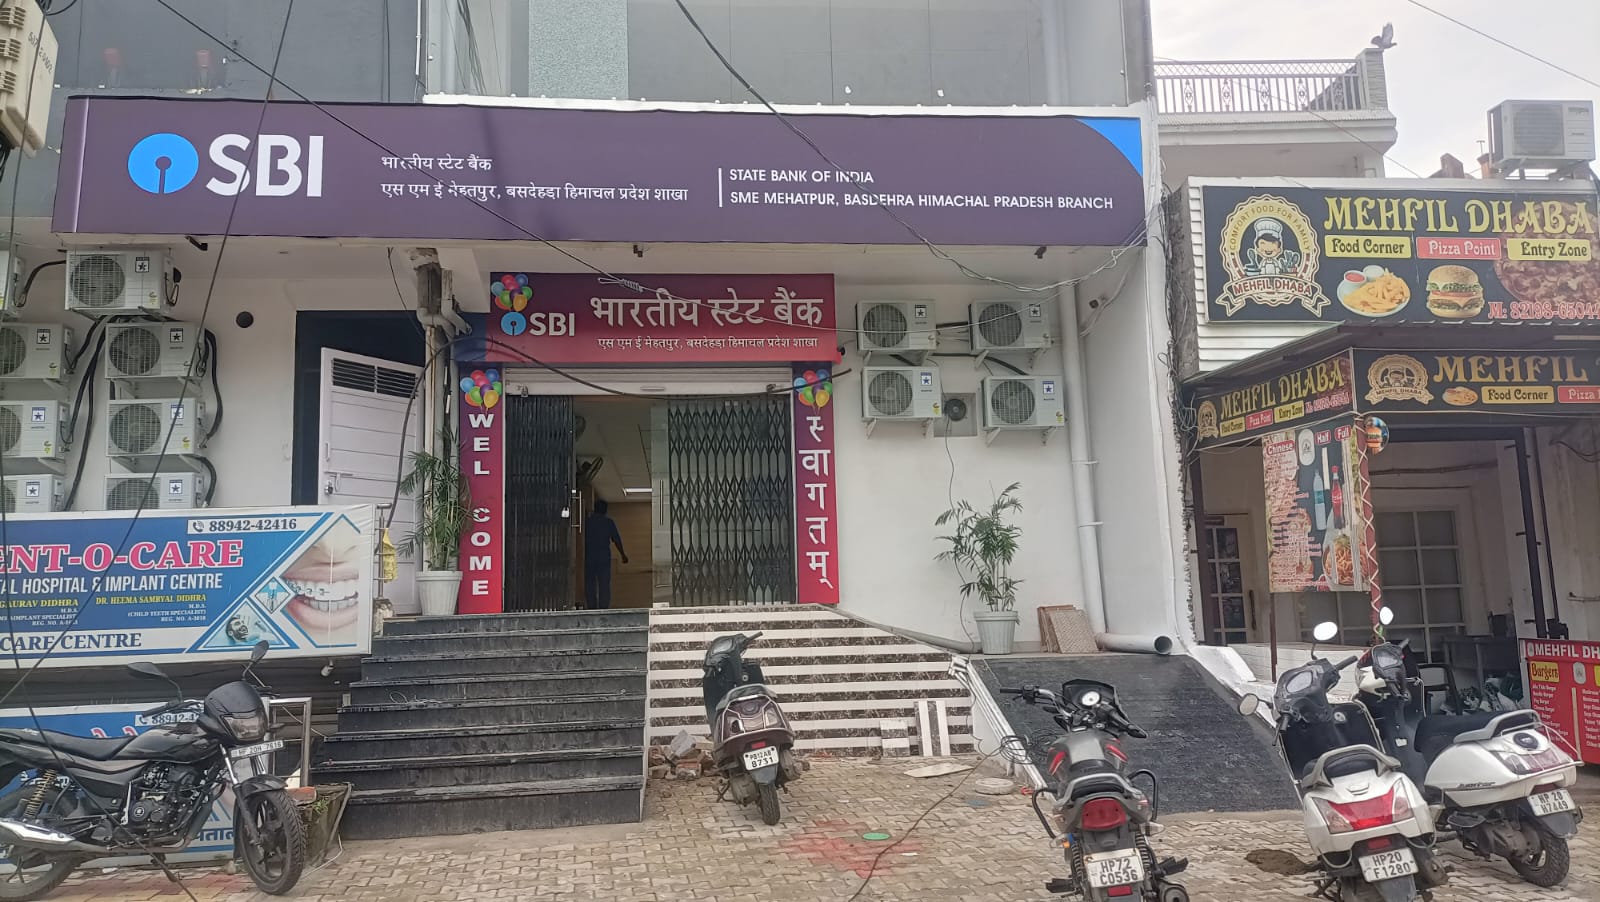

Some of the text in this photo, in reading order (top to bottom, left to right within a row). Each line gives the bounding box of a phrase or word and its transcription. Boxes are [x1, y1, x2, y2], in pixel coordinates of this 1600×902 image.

[206, 133, 323, 198] SBI
[381, 153, 493, 171] भारतीय स्टेट बैंक
[729, 169, 874, 183] STATE BANK OF INDIA
[381, 183, 404, 198] एस
[408, 184, 430, 198] एम
[433, 180, 444, 199] ई
[564, 183, 615, 199] हिमाचल
[619, 184, 650, 200] प्रदेश
[654, 188, 688, 201] शाखा
[730, 191, 1113, 209] SME MEHATPUR, BASDEHRA HIMACHAL PRADESH BRANCH
[1324, 197, 1594, 235] MEHFIL DHABA
[1229, 205, 1311, 251] COMFORT FOOD FOR FAMILY
[1332, 239, 1404, 255] Food Corner
[1428, 241, 1495, 256] Pizza Point
[1521, 241, 1588, 260] Entry Zone
[1233, 279, 1312, 296] MEHFIL DHABA
[590, 287, 824, 328] भारतीय स्टेट बैंक
[1488, 301, 1507, 319] M:
[529, 313, 575, 337] SBI
[597, 338, 614, 349] एस
[617, 338, 632, 349] एम
[635, 336, 642, 350] ई
[728, 336, 765, 348] हिमाचल
[767, 336, 790, 348] प्रदेश
[793, 337, 818, 348] शाखा
[1433, 355, 1589, 383] MEHFIL
[1221, 381, 1276, 420] MEHFIL
[1279, 359, 1345, 403] DHABA
[1487, 388, 1548, 401] Food Corner
[1569, 388, 1595, 400] Pizza
[468, 413, 494, 476] WEL
[209, 518, 297, 532] 88942-42416
[469, 508, 492, 596] COME
[0, 573, 223, 595] AL HOSPITAL & IMPLANT CENTRE
[0, 633, 142, 651] CARE CENTRE
[1535, 643, 1579, 658] MEHFIL
[1100, 858, 1132, 873] HP72
[1372, 851, 1402, 867] HP20
[1100, 869, 1138, 885] C0536
[1373, 862, 1411, 879] F1280
